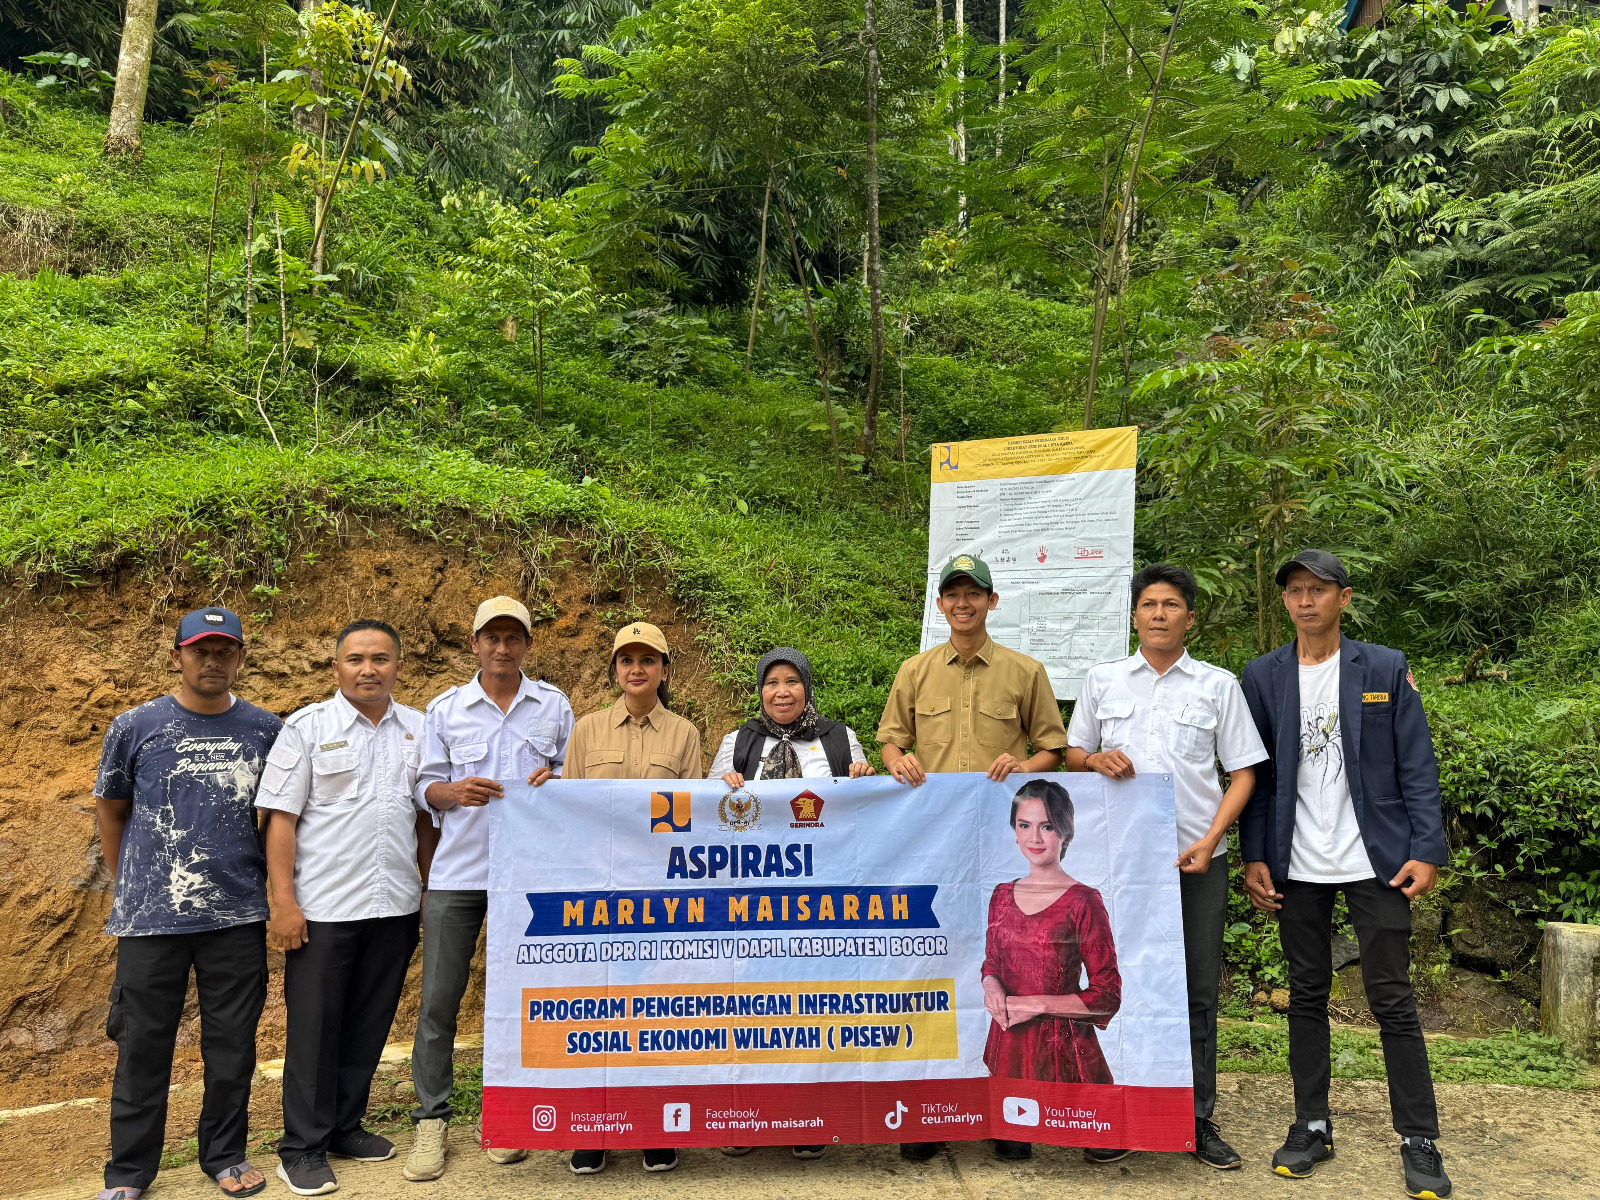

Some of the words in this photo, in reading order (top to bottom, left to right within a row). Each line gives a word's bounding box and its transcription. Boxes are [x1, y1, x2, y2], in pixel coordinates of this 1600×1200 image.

[176, 737, 242, 756] Everyday
[171, 758, 242, 776] Beginning
[789, 821, 825, 829] GERINDRA
[666, 843, 814, 879] ASPIRASI
[563, 897, 704, 927] MARLYN
[728, 894, 909, 922] MAISARAH
[517, 942, 597, 964] ANGGOTA
[600, 941, 635, 962] DPR
[639, 940, 657, 961] RI
[661, 939, 718, 960] KOMISI
[721, 938, 735, 959] V
[737, 938, 786, 958] DAPIL
[789, 936, 887, 957] KABUPATEN
[890, 936, 948, 957] BOGOR
[529, 997, 626, 1021] PROGRAM
[632, 994, 792, 1019] PENGEMBANGAN
[798, 990, 950, 1015] INFRASTRUKTUR
[566, 1030, 633, 1055] SOSIAL
[638, 1028, 727, 1053] EKONOMI
[732, 1026, 821, 1050] WILAYAH
[840, 1025, 901, 1048] PISEW
[706, 1108, 760, 1119] Facebook/
[920, 1102, 958, 1114] TikTok/
[1044, 1105, 1097, 1119] YouTube/
[570, 1110, 628, 1123] Instagram/
[705, 1120, 726, 1130] ceu
[728, 1118, 769, 1133] marlyn
[771, 1116, 824, 1129] maisarah
[921, 1112, 983, 1126] ceu.marlyn
[1044, 1117, 1111, 1132] ceu.marlyn
[570, 1121, 633, 1134] ceu.marlyn
